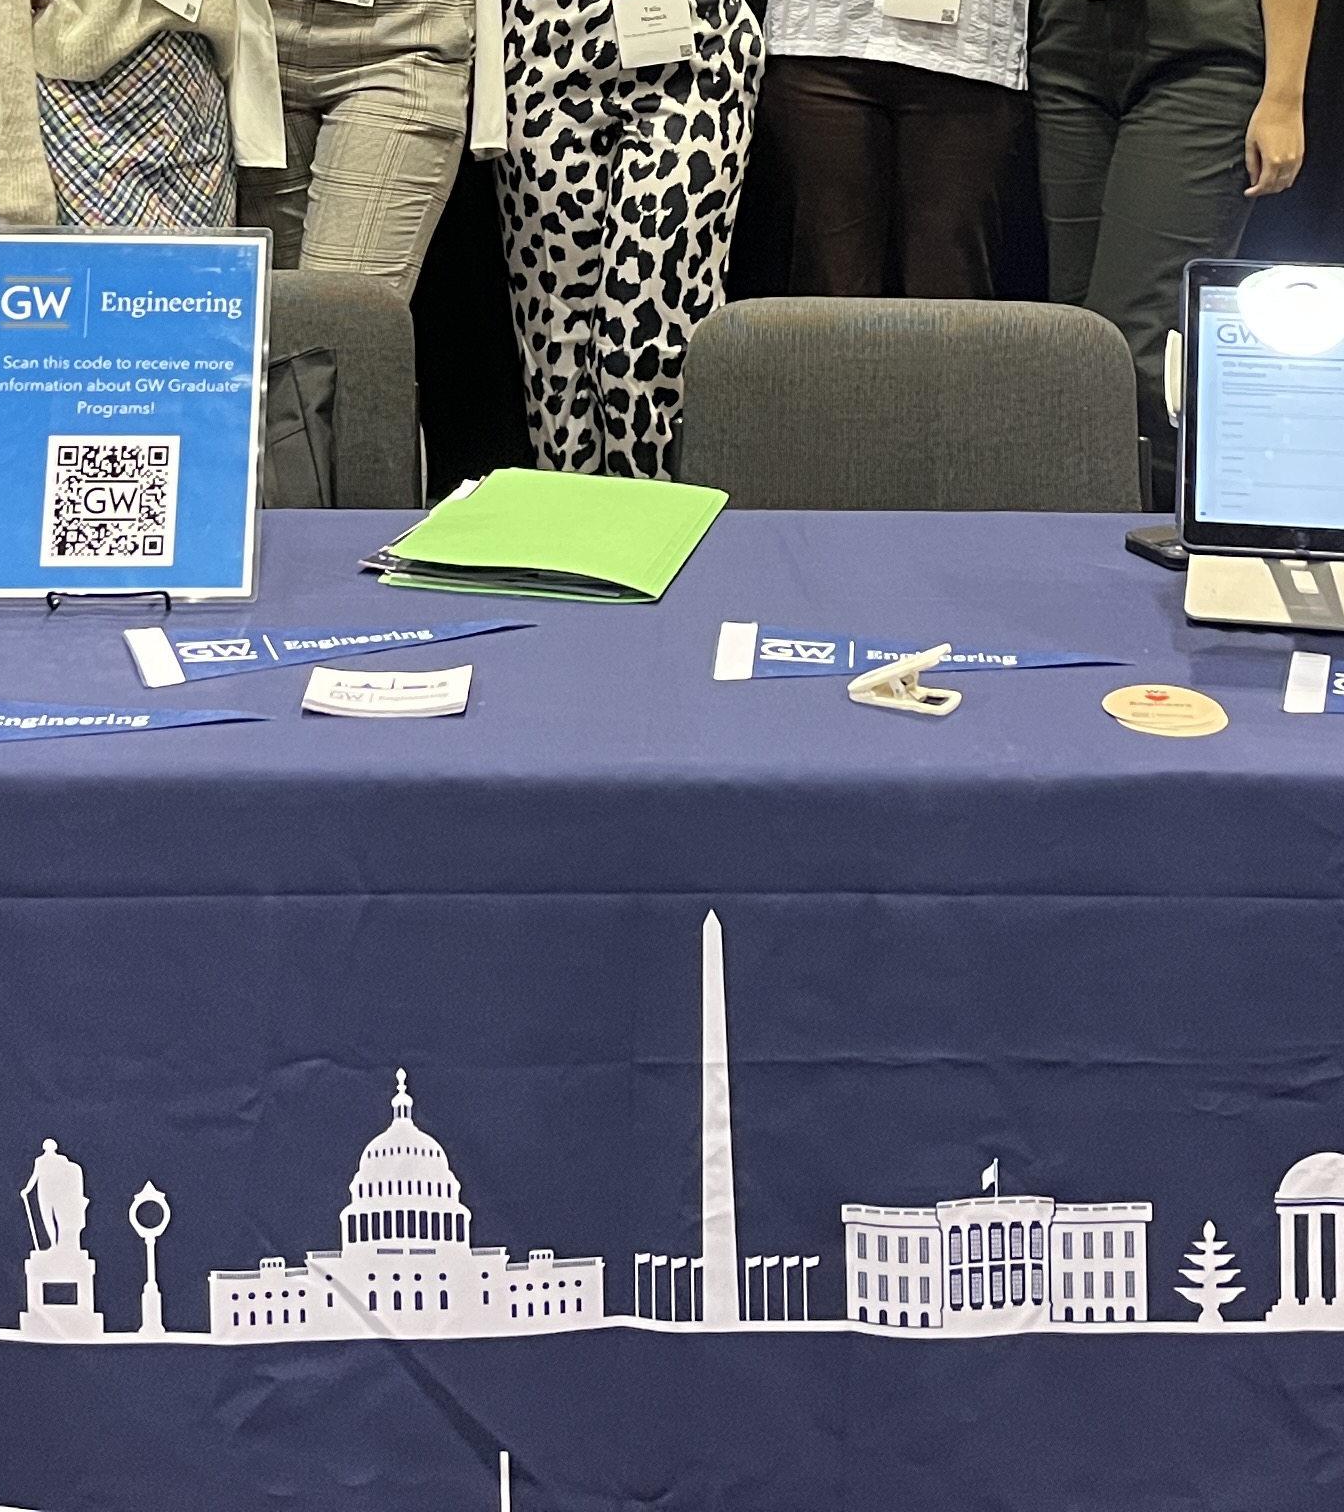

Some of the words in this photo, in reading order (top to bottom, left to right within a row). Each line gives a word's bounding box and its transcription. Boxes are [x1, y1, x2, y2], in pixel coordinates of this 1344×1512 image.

[0, 284, 72, 321] GW
[100, 290, 243, 319] Engineering
[2, 355, 39, 370] Scan
[43, 355, 70, 370] this
[73, 355, 112, 370] code
[116, 357, 132, 371] to
[135, 357, 190, 371] receive
[194, 358, 235, 371] more
[86, 377, 131, 393] about
[134, 378, 166, 393] GW
[167, 378, 239, 393] Graduate
[76, 400, 156, 419] Programs!
[83, 487, 139, 515] GW
[179, 642, 252, 659] GW
[283, 629, 434, 651] Engineering
[760, 642, 836, 659] GW
